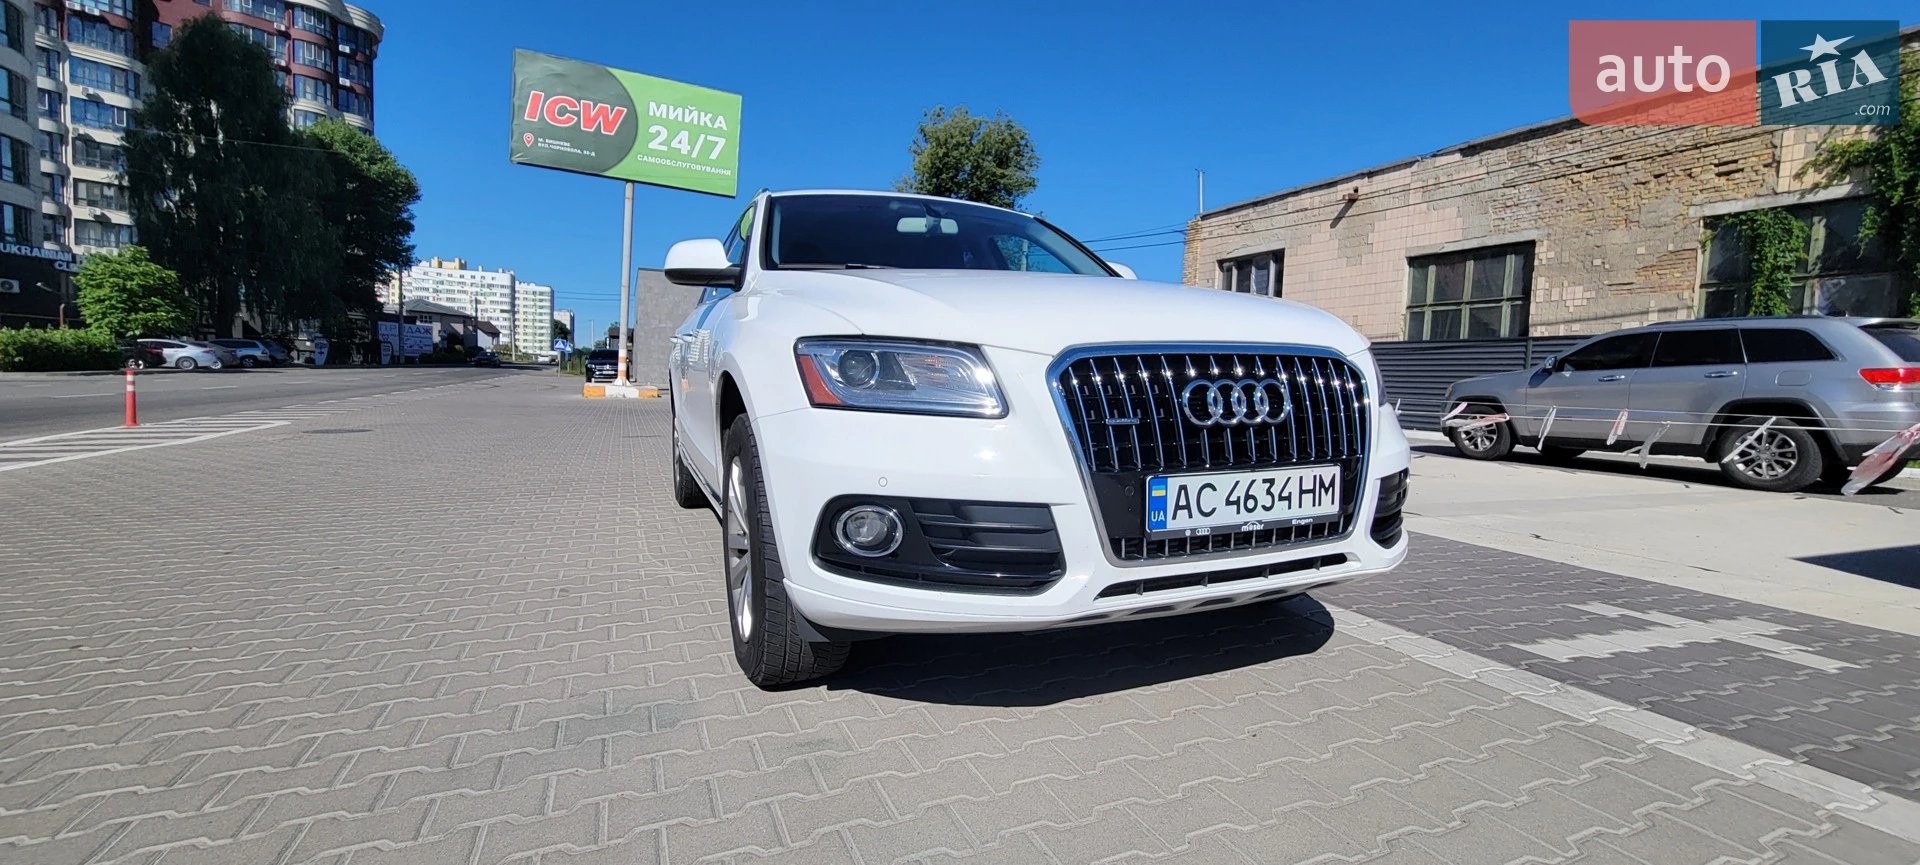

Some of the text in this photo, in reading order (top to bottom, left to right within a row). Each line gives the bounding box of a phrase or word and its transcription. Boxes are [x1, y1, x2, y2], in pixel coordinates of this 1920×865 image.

[524, 90, 627, 135] ICW
[648, 101, 728, 131] МИЙКА
[648, 124, 726, 160] 24/7
[637, 154, 731, 176] САМООБСЛУГОВУВАННЯ
[0, 242, 72, 261] UKRAINIAN
[380, 323, 432, 335] ПРДАЖ
[1171, 473, 1337, 521] AC 4634 HM
[1151, 510, 1166, 522] UA
